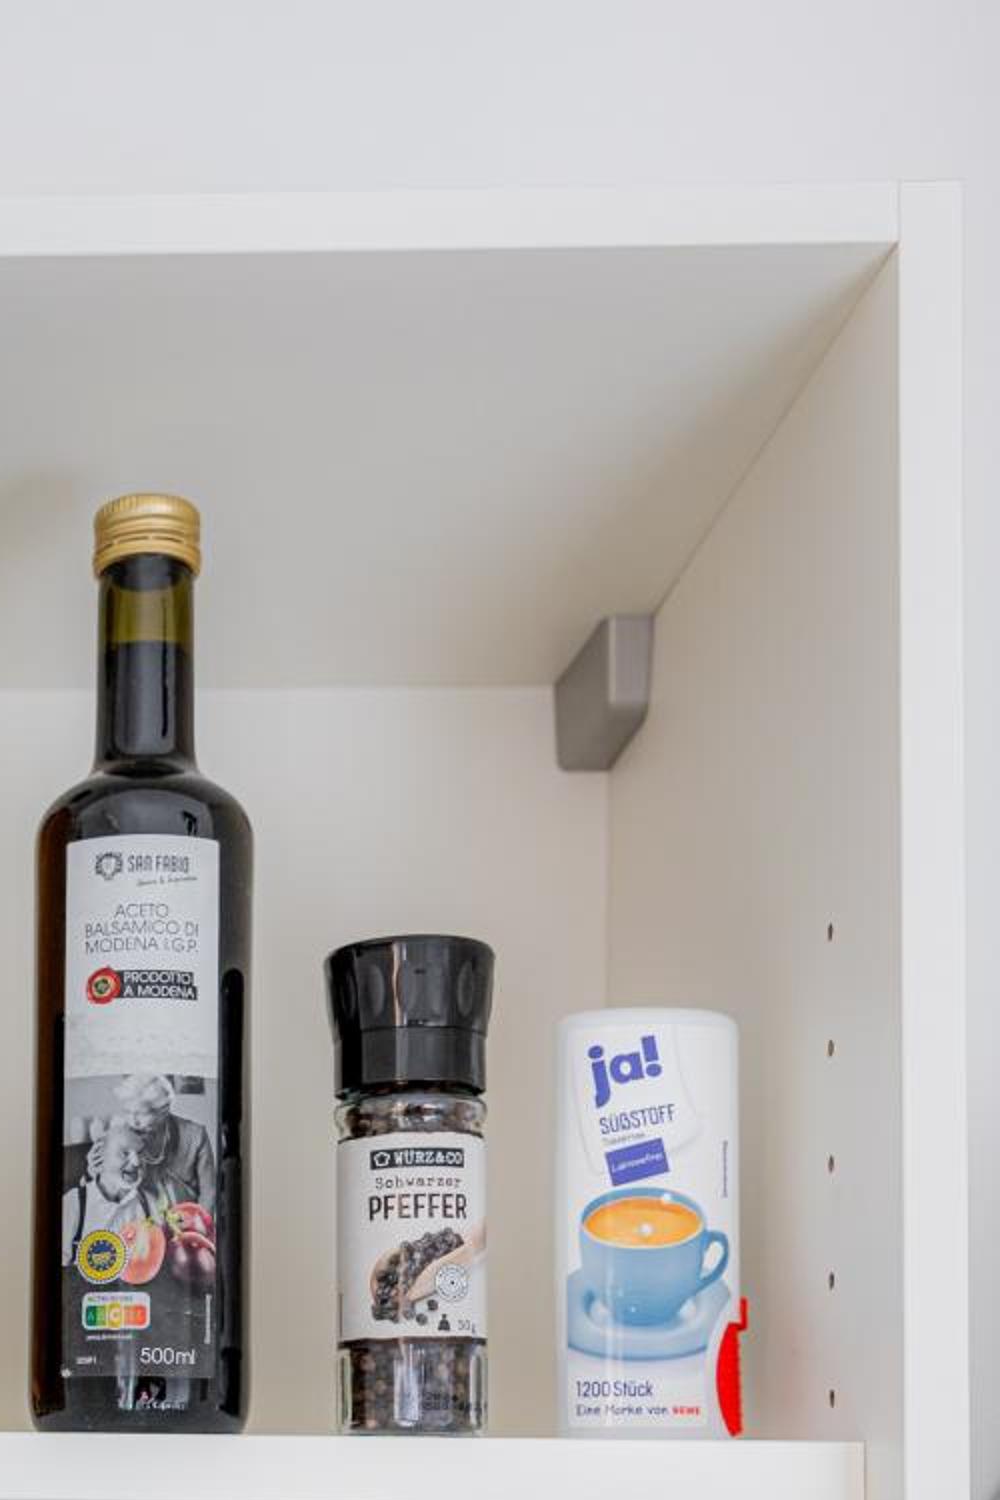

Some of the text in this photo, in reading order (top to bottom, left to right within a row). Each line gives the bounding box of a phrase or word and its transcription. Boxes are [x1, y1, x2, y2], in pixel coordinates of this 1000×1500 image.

[127, 854, 190, 874] SAN FABIO
[114, 903, 169, 919] ACETO
[85, 919, 199, 939] BALSAMICO DI
[85, 936, 159, 954] MODENA
[122, 971, 192, 985] PRODOTTO
[122, 984, 196, 999] A MODENA
[587, 1034, 663, 1109] ja!
[375, 1176, 463, 1190] Schwarzer
[368, 1193, 467, 1221] PFEFFER
[139, 1346, 196, 1365] 500ml
[576, 1379, 653, 1398] 1200 Stück
[605, 1403, 643, 1416] Marke
[647, 1405, 669, 1416] von
